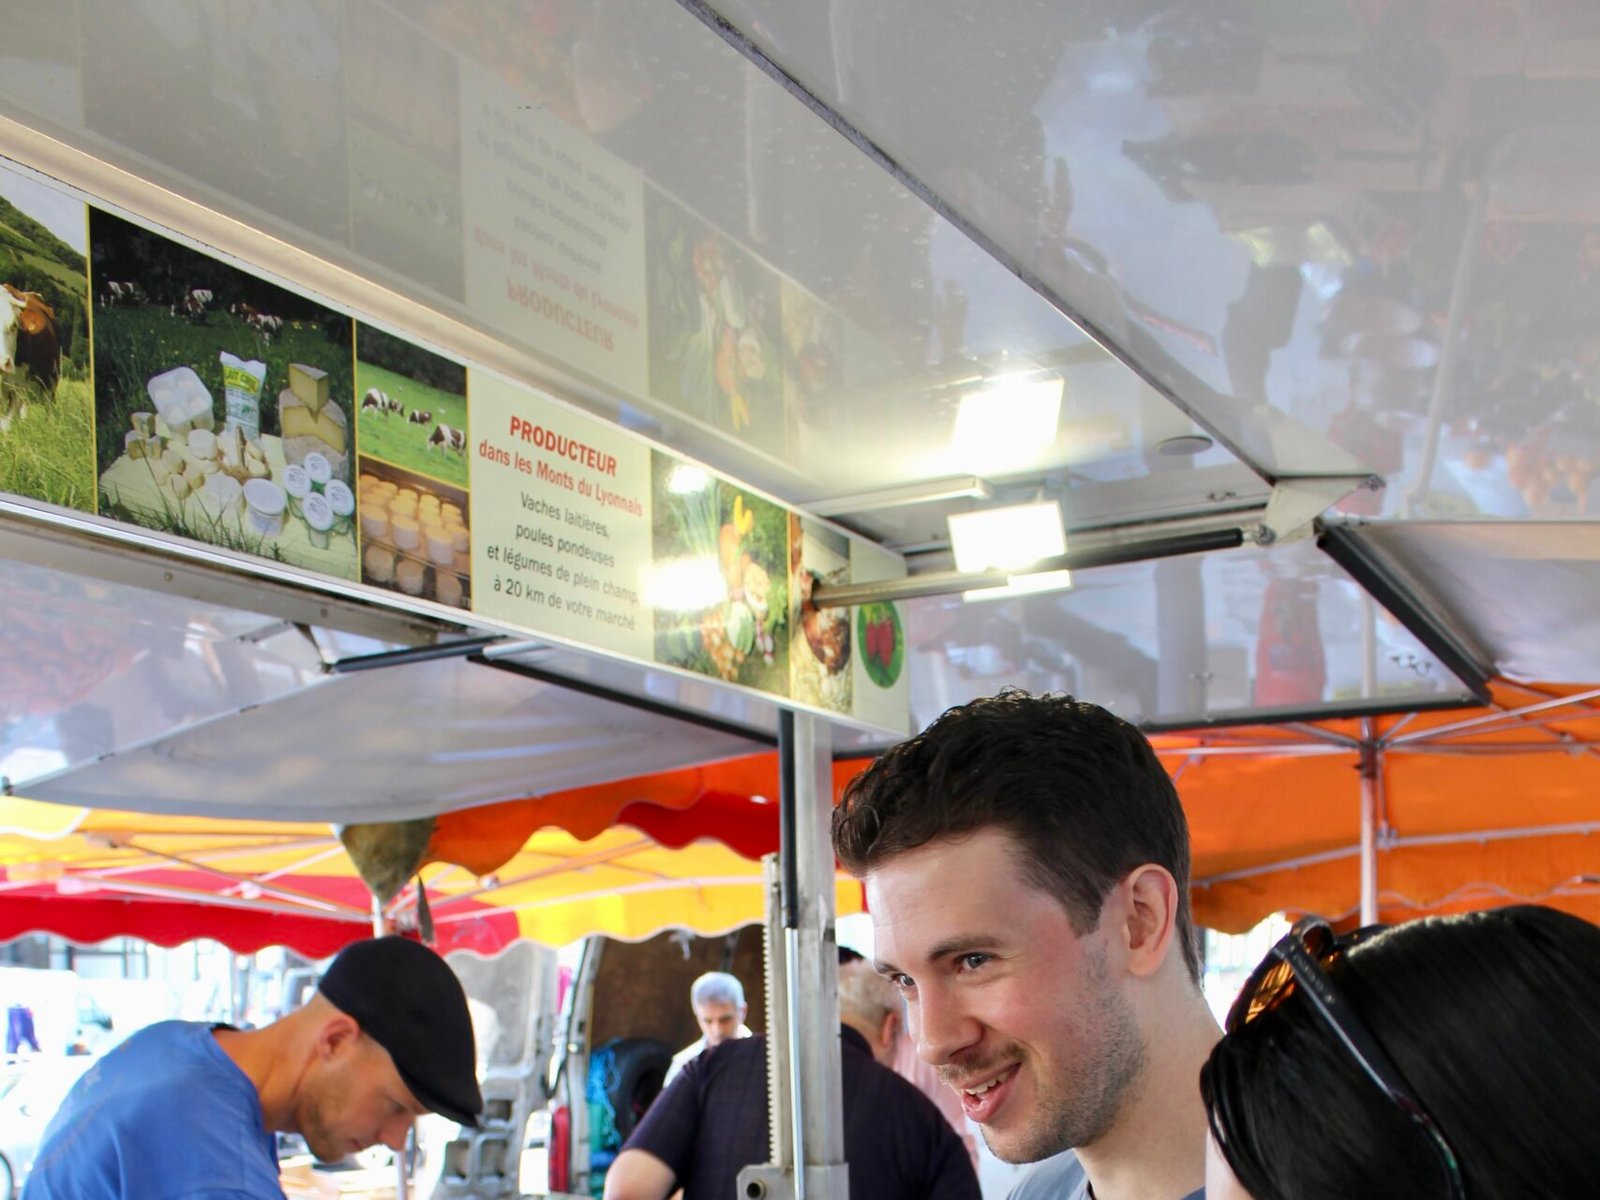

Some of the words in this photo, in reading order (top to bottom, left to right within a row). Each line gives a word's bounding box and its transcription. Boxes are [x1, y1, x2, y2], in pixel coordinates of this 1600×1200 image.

[509, 415, 617, 478] PRODUCTEUR
[479, 440, 511, 467] dans
[514, 452, 533, 475] les
[536, 459, 575, 491] Monts
[578, 477, 592, 497] du
[596, 483, 643, 517] Lyonnais
[520, 491, 561, 521] Vaches
[565, 507, 611, 540] laitières,
[487, 545, 499, 561] et
[503, 547, 553, 577] légumes
[556, 564, 570, 583] de
[573, 571, 600, 591] plein
[515, 524, 554, 548] poules
[557, 538, 615, 569] pondeuses
[493, 574, 502, 592] à
[505, 578, 523, 598] 20
[526, 584, 545, 604] km
[548, 593, 562, 609] de
[565, 599, 593, 618] votre
[596, 608, 636, 631] marché
